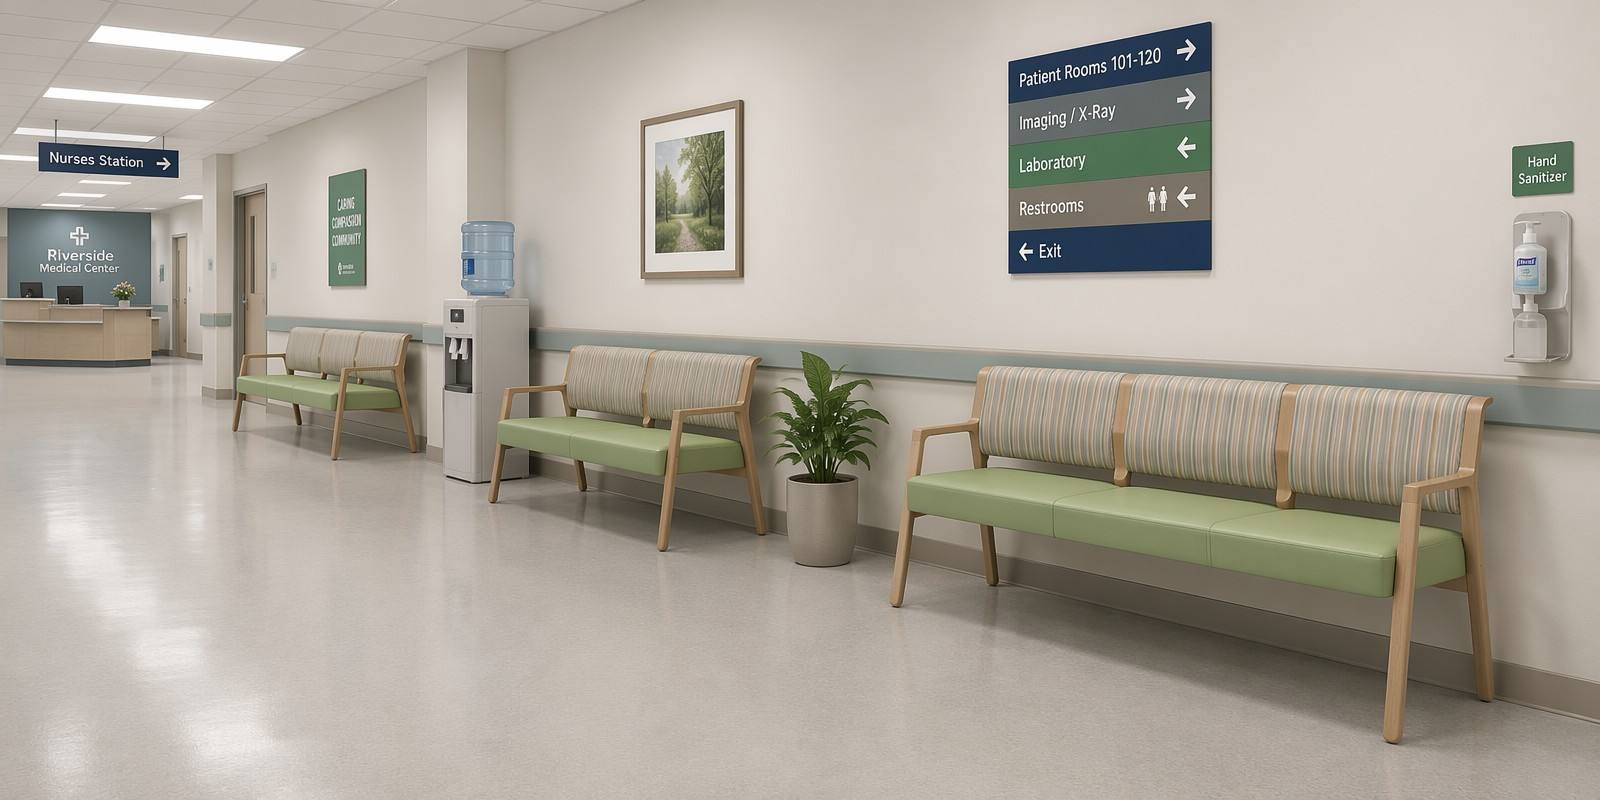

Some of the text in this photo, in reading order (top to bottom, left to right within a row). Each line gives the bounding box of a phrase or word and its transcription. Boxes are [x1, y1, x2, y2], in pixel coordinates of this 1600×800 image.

[1019, 47, 1162, 88] Patient Rooms 101-120
[1019, 103, 1116, 130] Imaging / X-Ray
[49, 151, 144, 168] Nurses Station
[1019, 153, 1086, 173] Laboratory
[1527, 154, 1557, 168] Hand
[1518, 170, 1567, 185] Sanitizer
[1019, 199, 1085, 216] Restrooms
[47, 248, 114, 261] Riverside
[1039, 243, 1062, 259] Exit
[40, 263, 120, 273] Medical Center
